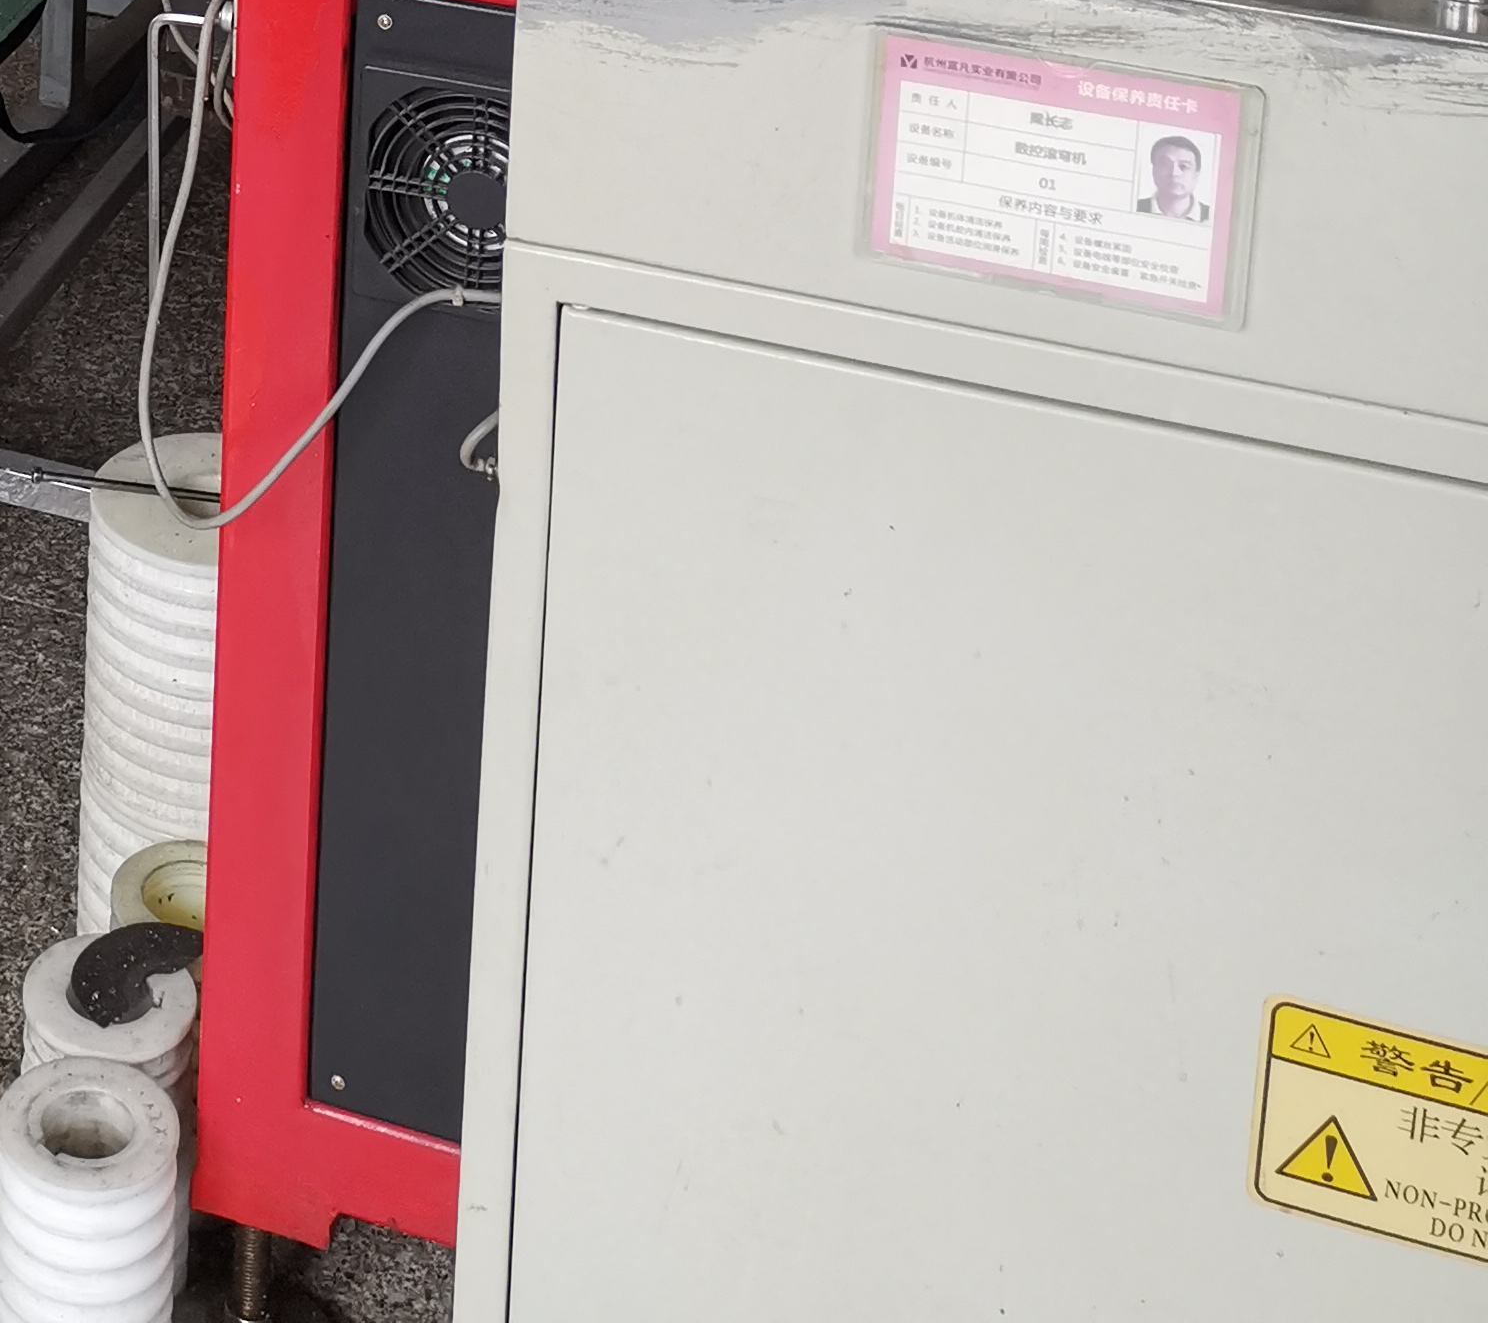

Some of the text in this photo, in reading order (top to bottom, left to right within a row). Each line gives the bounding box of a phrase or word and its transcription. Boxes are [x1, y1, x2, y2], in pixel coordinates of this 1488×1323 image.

[1078, 80, 1198, 114] 设备保养责任卡
[1038, 177, 1056, 191] 01
[999, 195, 1103, 225] 保养内容与要求
[1360, 1040, 1474, 1094] 警告
[1397, 1106, 1488, 1156] 非专
[1384, 1178, 1488, 1224] NON-PR
[1429, 1217, 1464, 1243] DO
